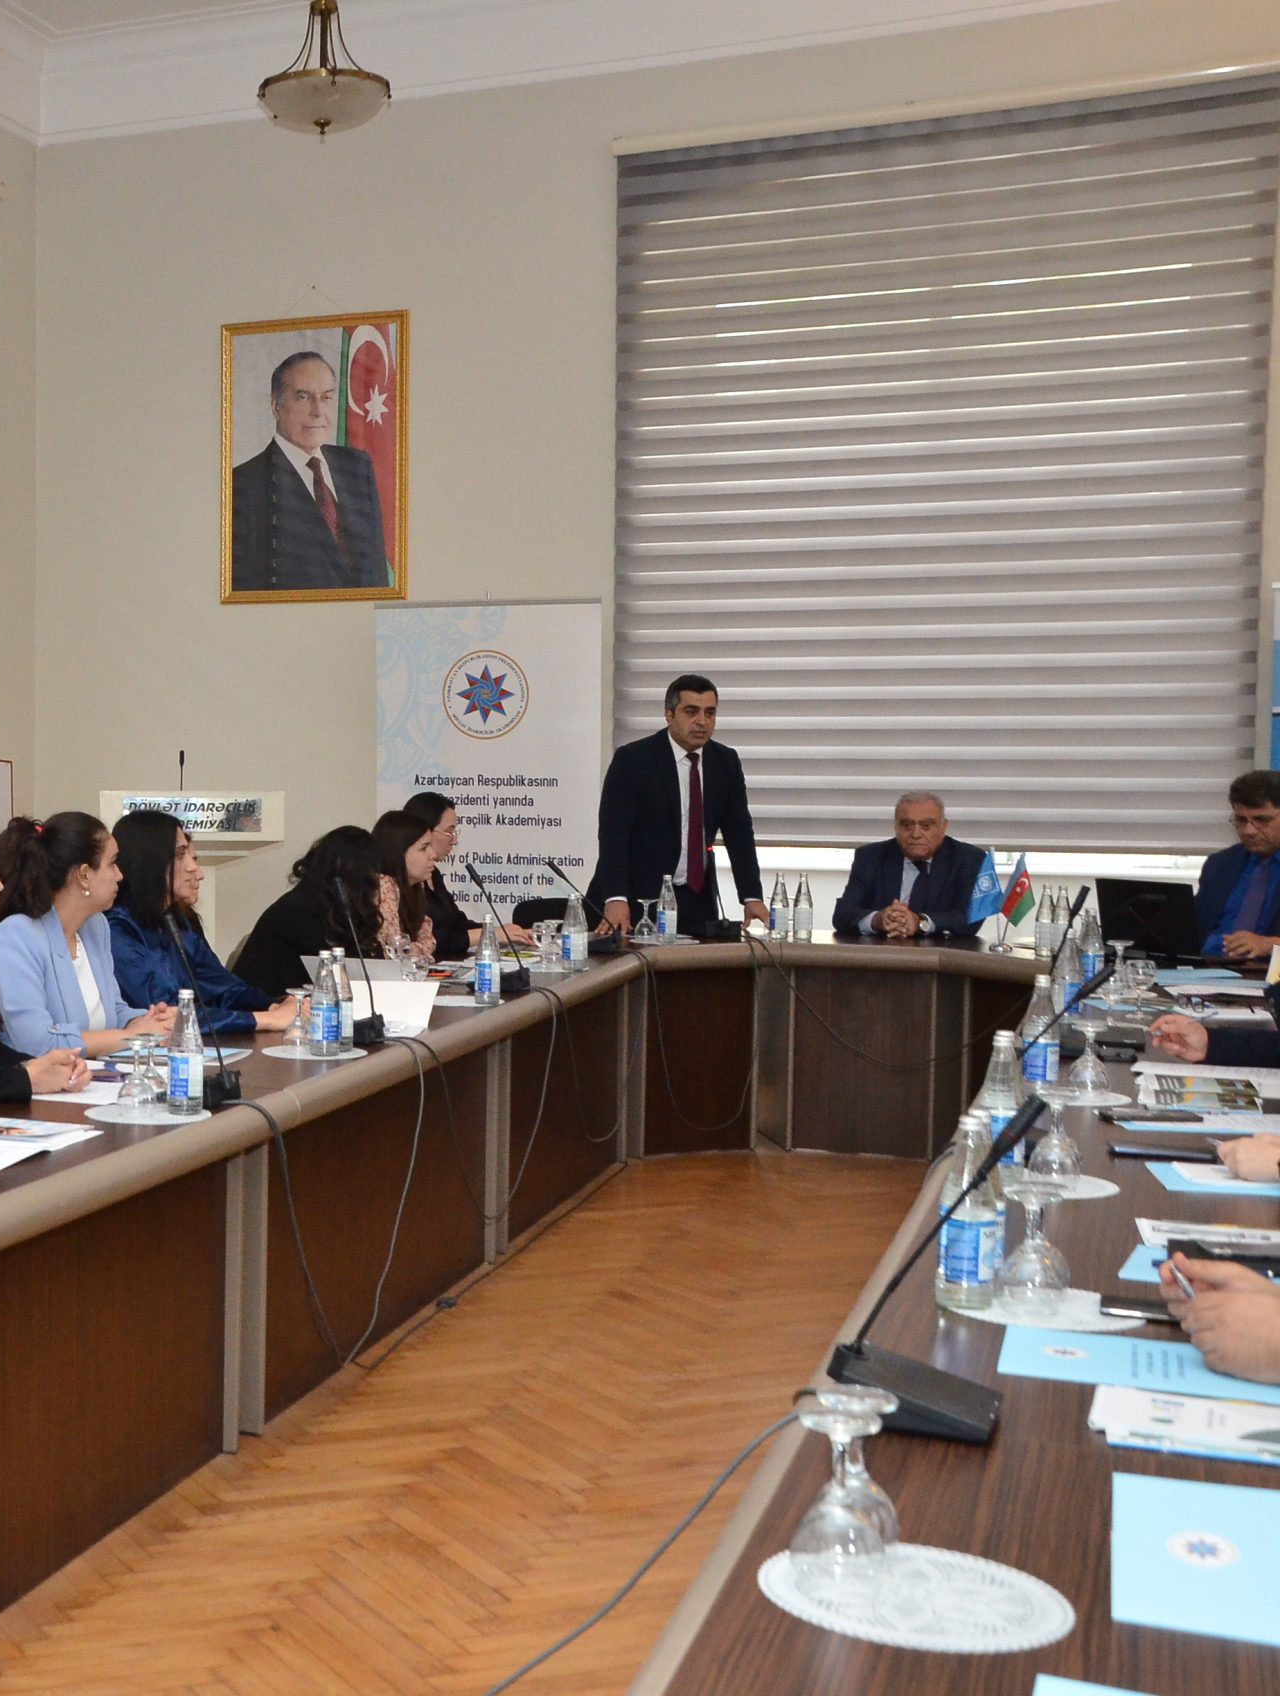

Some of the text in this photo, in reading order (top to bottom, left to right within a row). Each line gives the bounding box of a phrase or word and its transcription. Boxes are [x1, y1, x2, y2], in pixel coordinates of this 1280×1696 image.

[414, 774, 559, 789] Azərbaycan Respublikasının
[184, 798, 257, 814] İDARƏÇİLİK
[448, 793, 534, 809] ezidenti yanında
[181, 816, 237, 829] EMİYASI
[455, 813, 562, 829] arəçilik Akademiyası
[459, 852, 469, 864] of
[473, 852, 503, 865] Public
[506, 853, 584, 867] Administration
[450, 871, 467, 883] the
[470, 872, 520, 885] esident
[522, 873, 533, 885] of
[537, 874, 554, 886] the
[473, 891, 484, 903] of
